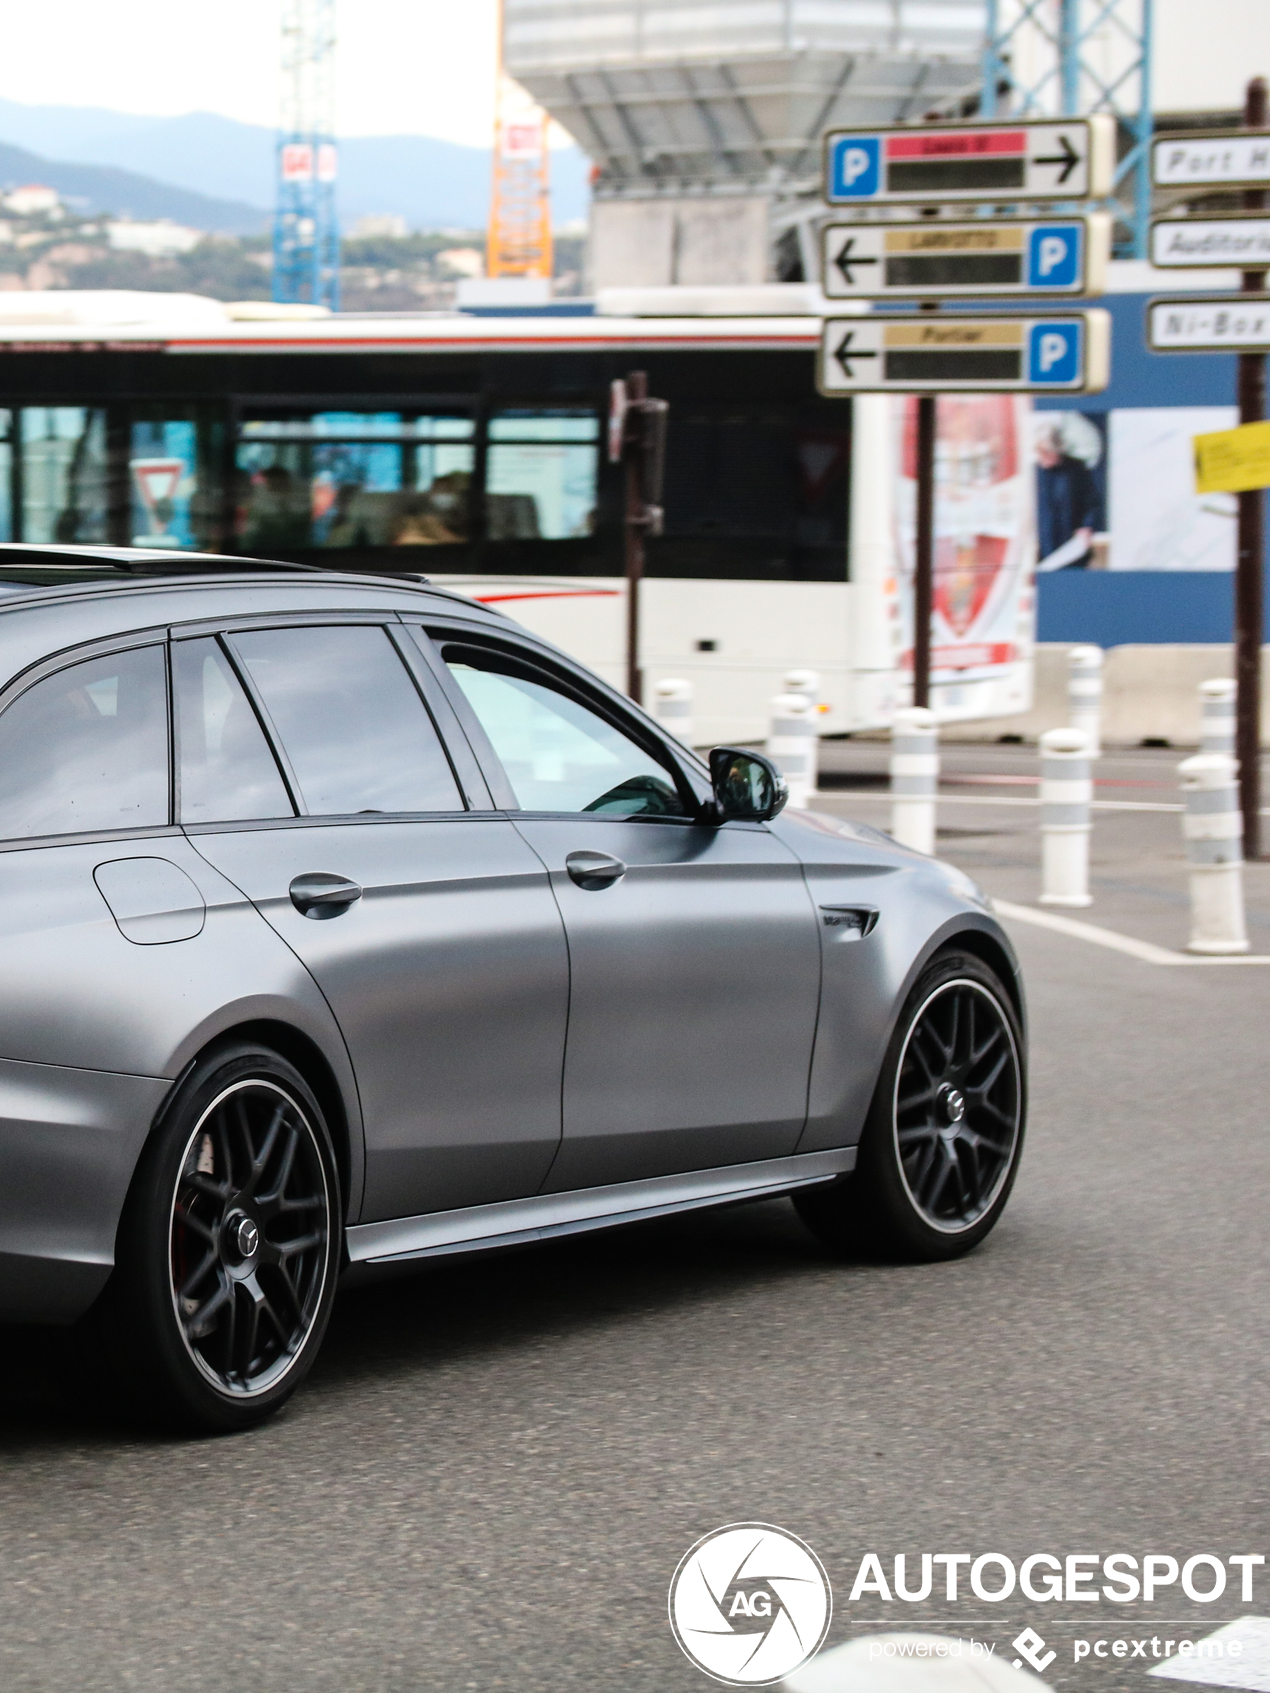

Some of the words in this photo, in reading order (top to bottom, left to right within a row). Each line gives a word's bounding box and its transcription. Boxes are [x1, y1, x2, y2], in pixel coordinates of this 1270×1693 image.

[842, 146, 870, 187] P
[1168, 150, 1232, 171] Port
[1039, 236, 1068, 276] P
[1039, 333, 1068, 373] P
